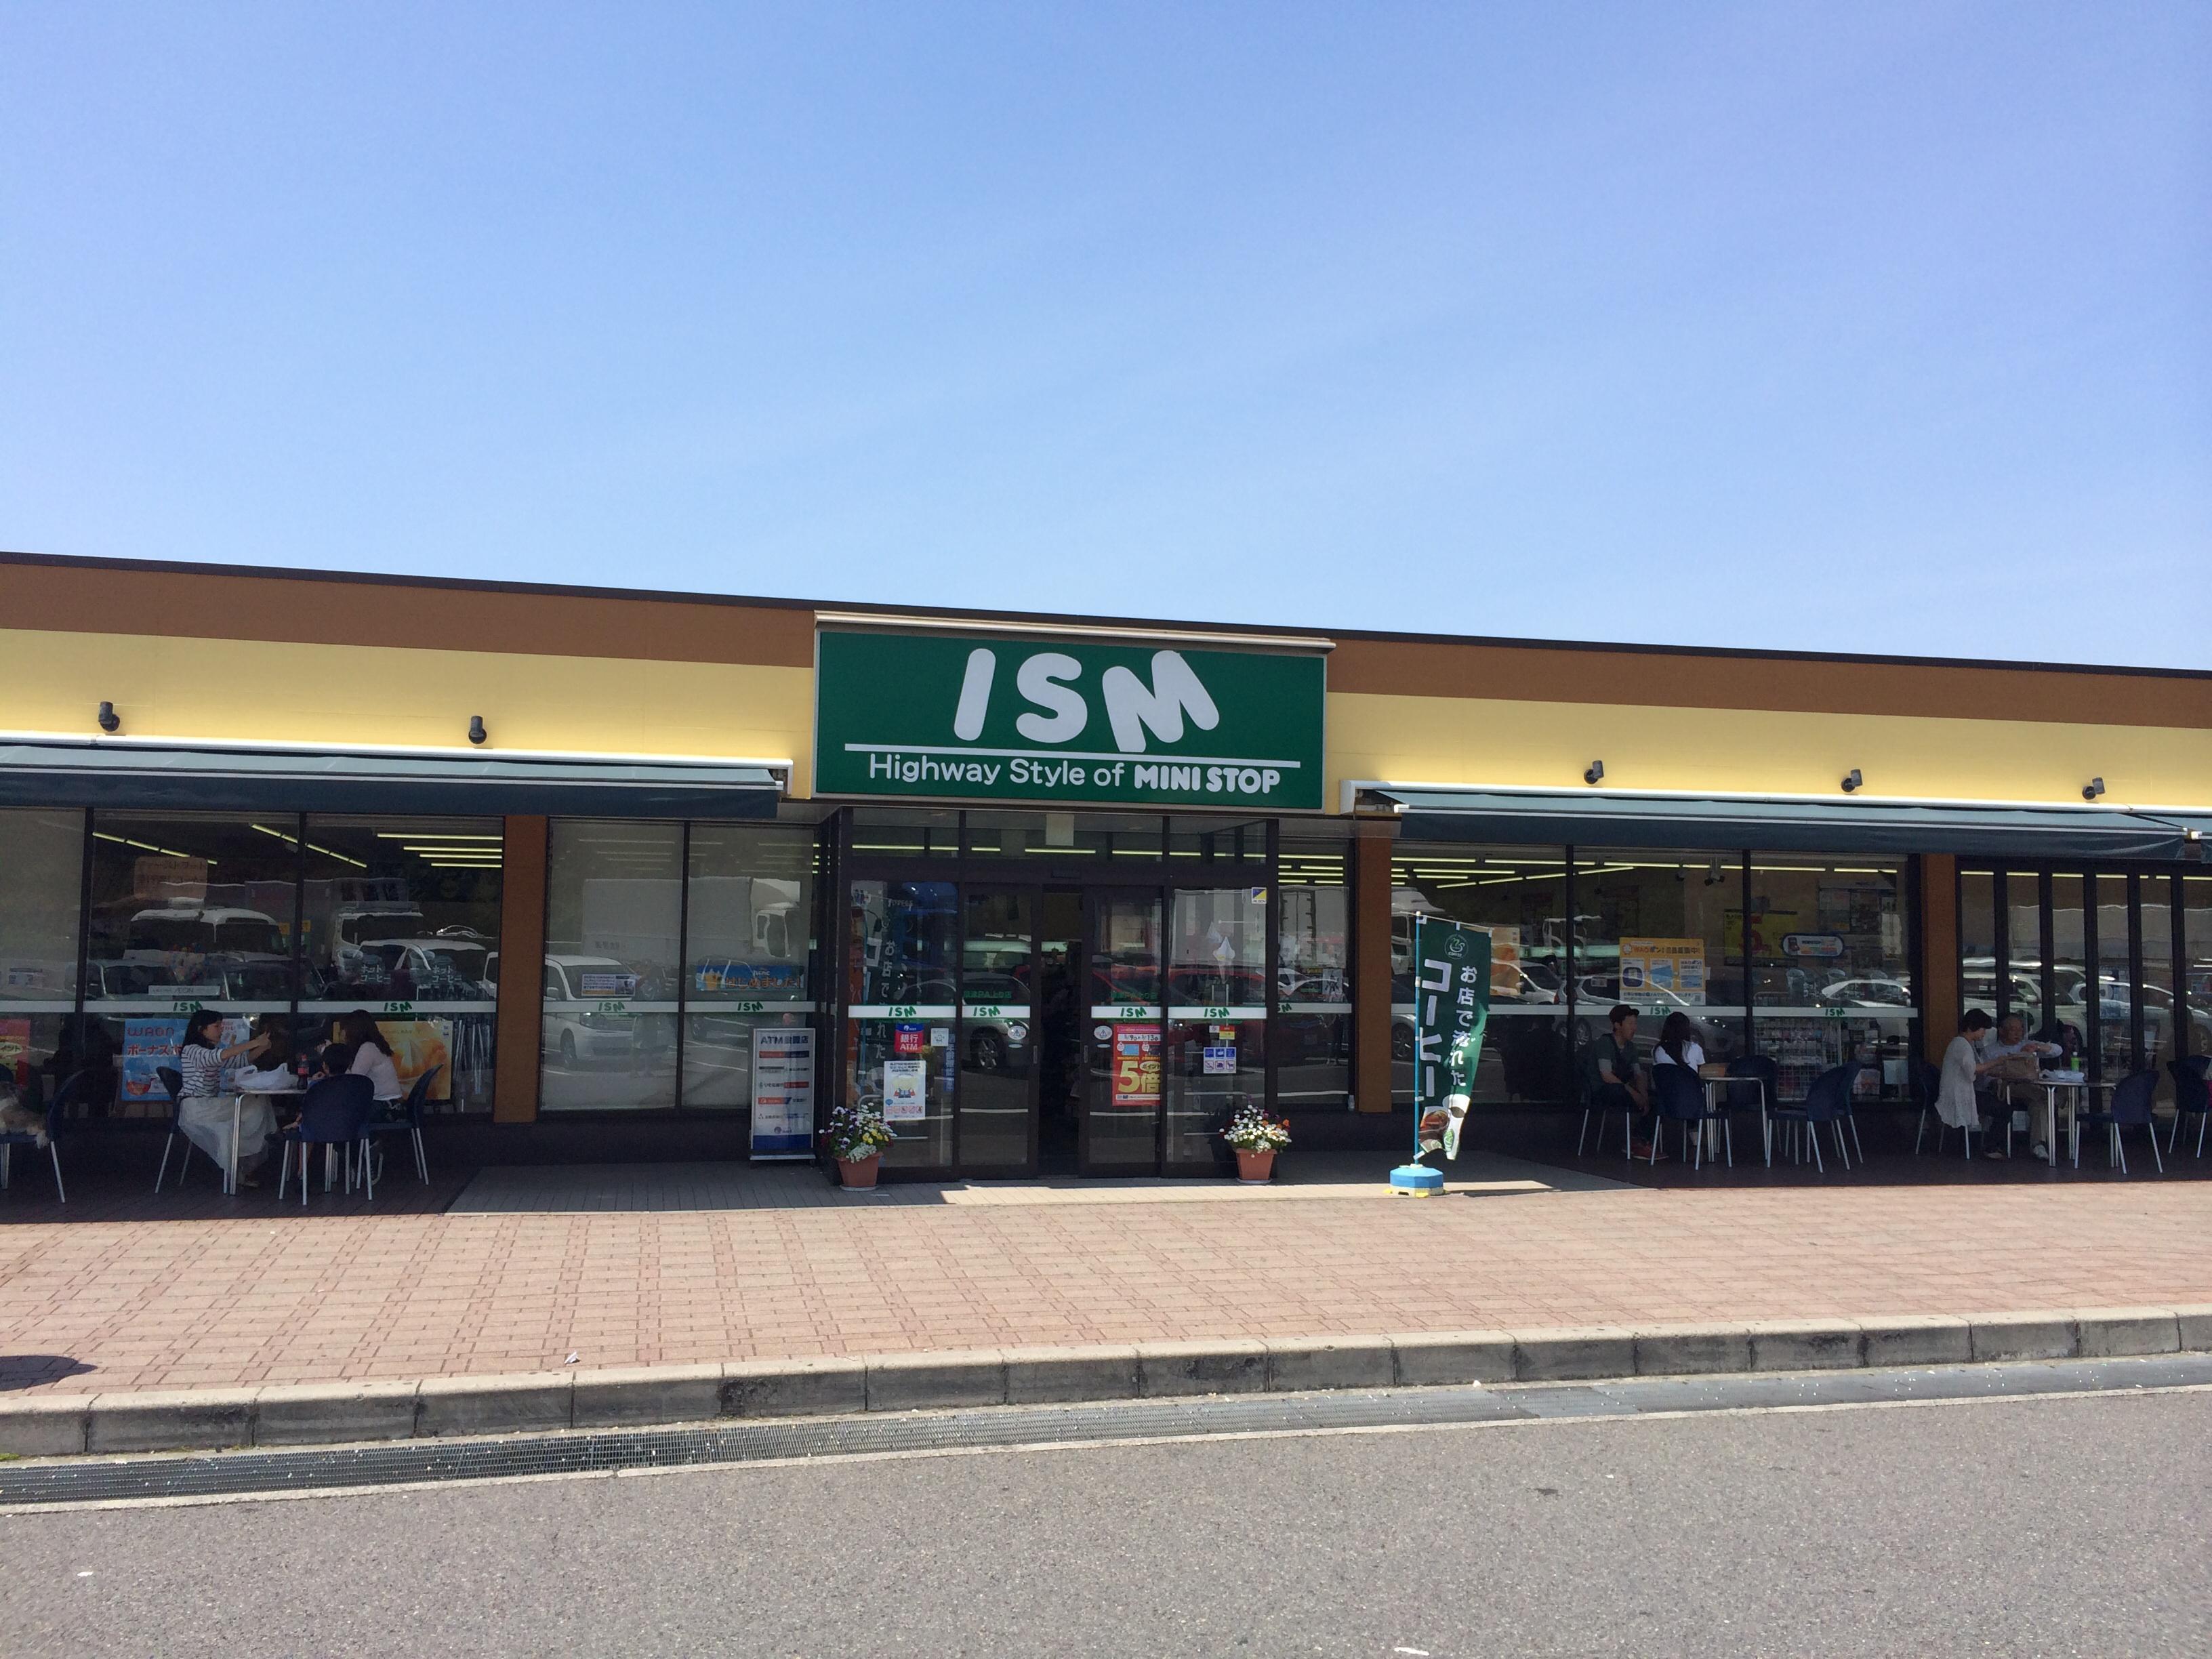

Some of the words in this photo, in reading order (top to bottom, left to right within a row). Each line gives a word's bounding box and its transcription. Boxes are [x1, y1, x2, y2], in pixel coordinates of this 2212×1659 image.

[954, 648, 1219, 753] ISM
[869, 753, 1000, 786] Highway
[1010, 758, 1084, 789] Style
[1093, 761, 1125, 787] of
[361, 975, 391, 983] コーヒー
[432, 975, 462, 983] コーヒー
[173, 1000, 203, 1012] ISM
[384, 1002, 413, 1012] ISM
[598, 1002, 626, 1012] ISM
[737, 1001, 764, 1012] ISM
[888, 1006, 917, 1017] ISM
[973, 1006, 1000, 1017] ISM
[1120, 1006, 1147, 1017] ISM
[1650, 1006, 1671, 1015] ISM
[1204, 1007, 1229, 1019] ISM
[1825, 1008, 1845, 1017] ISM
[1419, 959, 1452, 1097] コーヒー
[900, 1034, 918, 1043] 銀行
